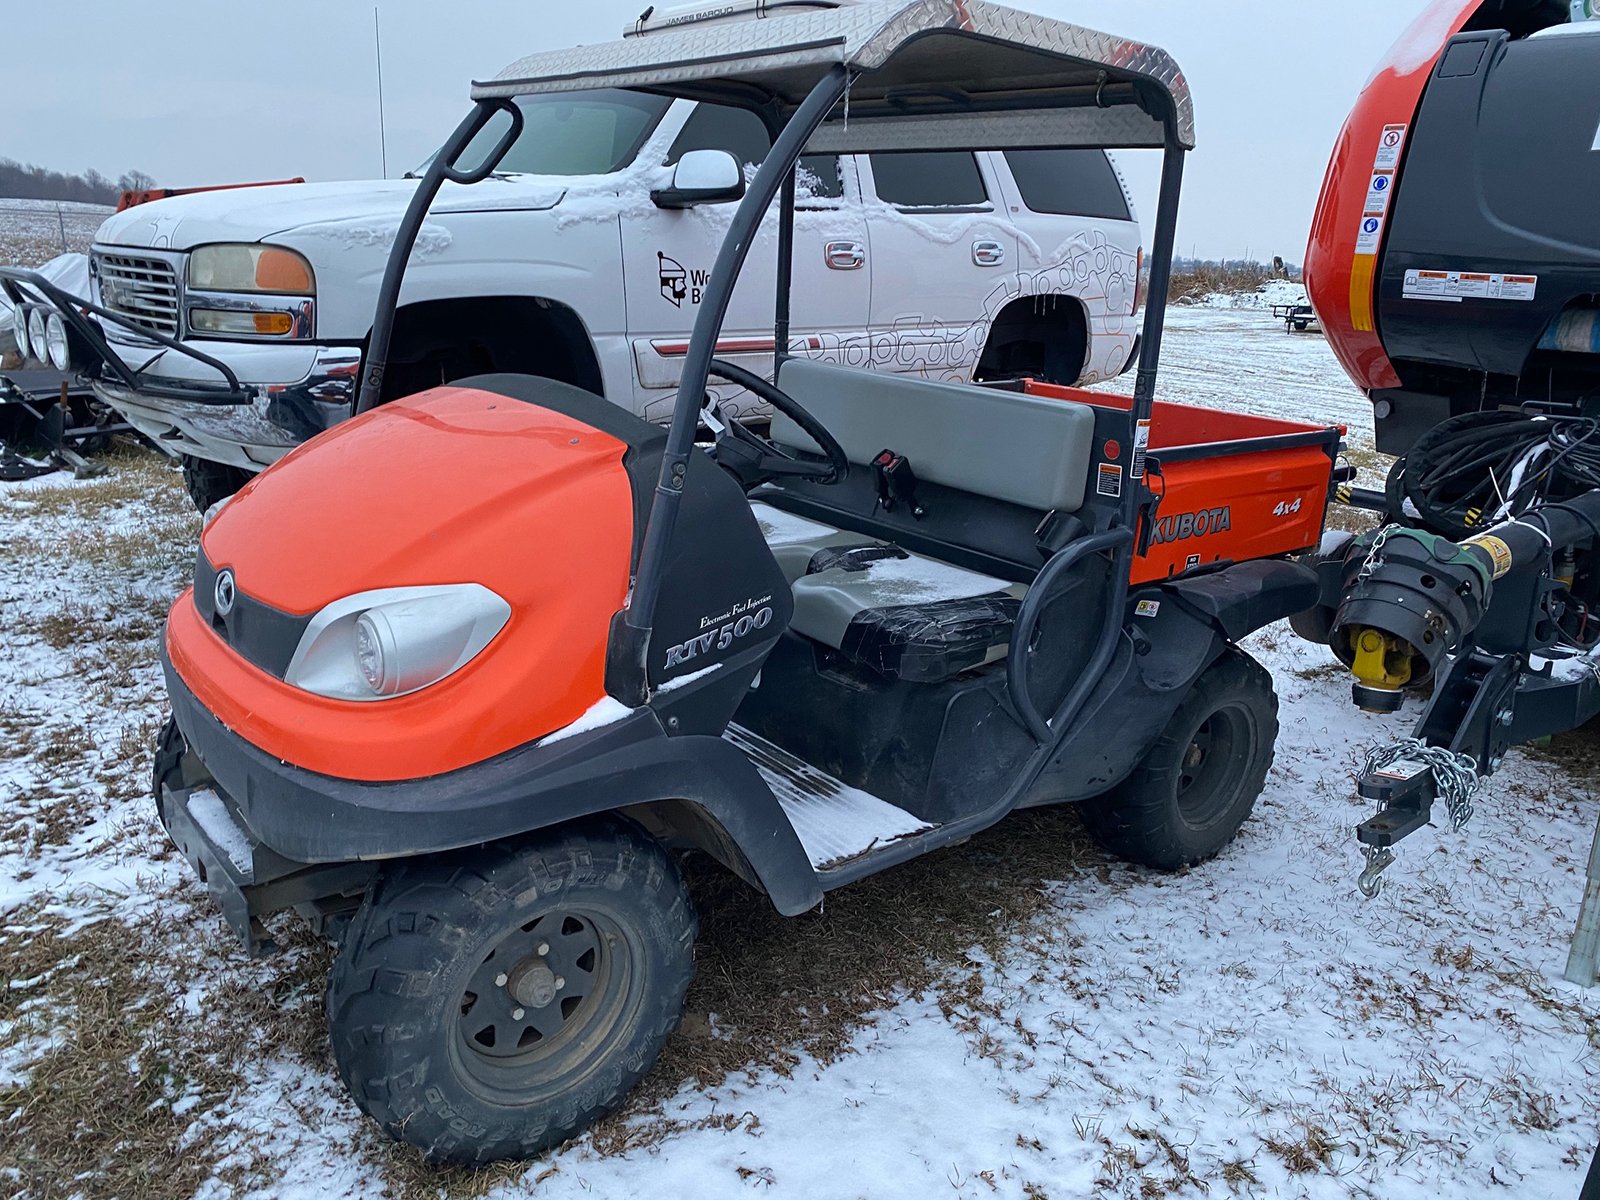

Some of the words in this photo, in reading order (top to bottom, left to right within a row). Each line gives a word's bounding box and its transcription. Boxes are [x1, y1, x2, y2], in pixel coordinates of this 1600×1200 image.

[1148, 505, 1231, 546] KUBOTA
[1272, 498, 1302, 517] 4x4
[699, 616, 731, 629] Electronic
[731, 603, 746, 616] Fuel
[747, 594, 772, 609] Injection
[663, 606, 773, 670] RTV500
